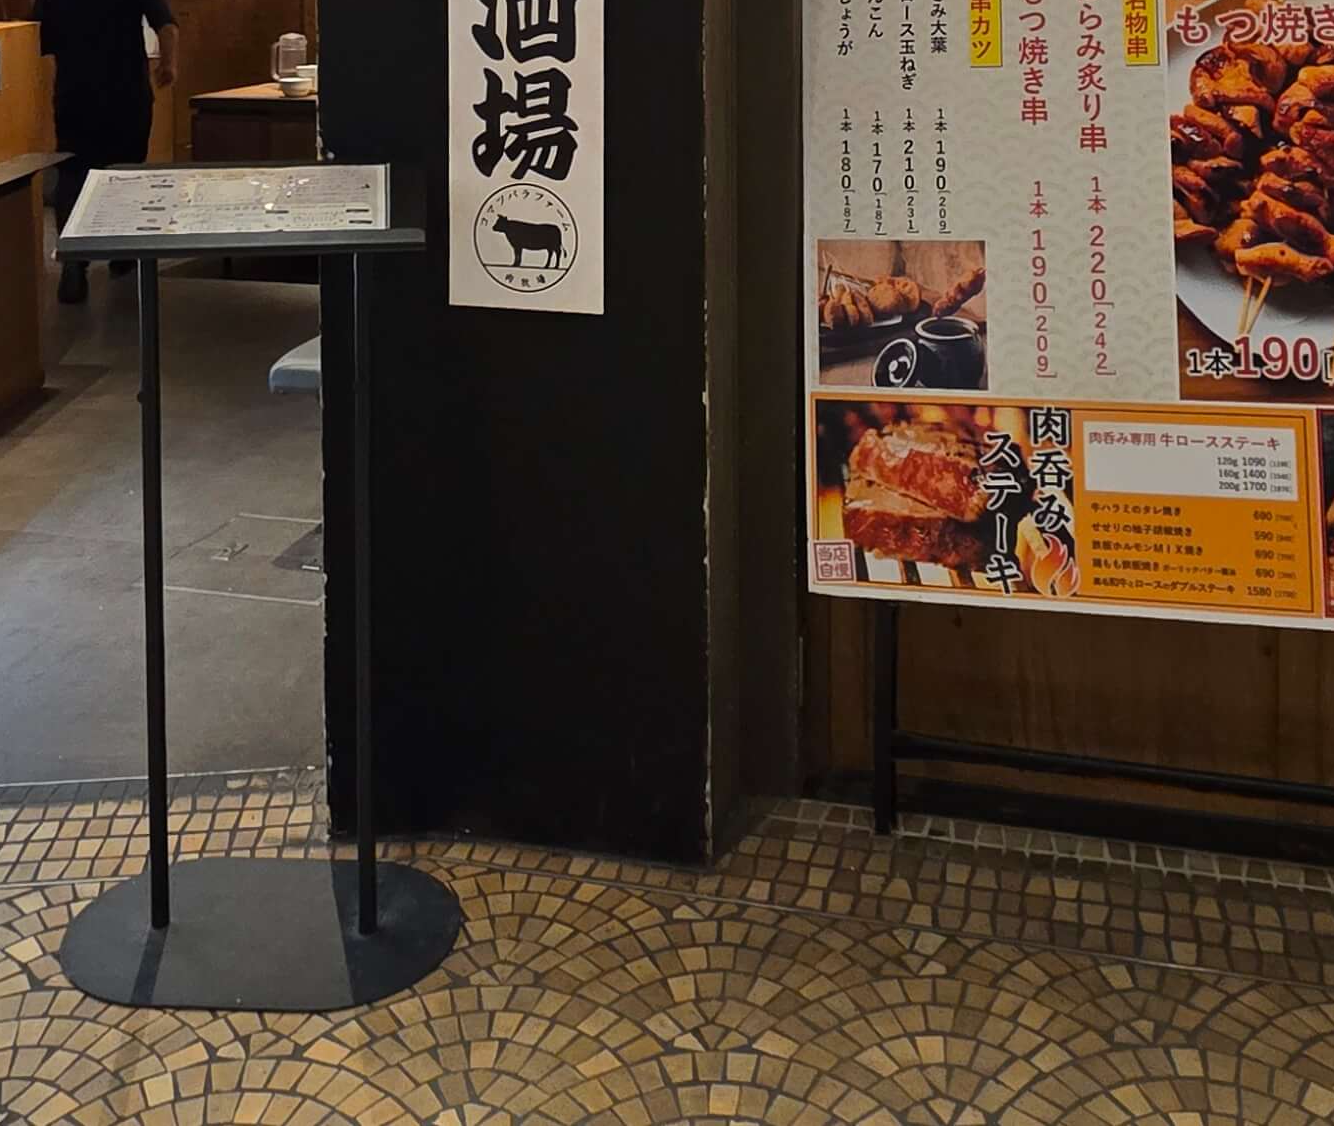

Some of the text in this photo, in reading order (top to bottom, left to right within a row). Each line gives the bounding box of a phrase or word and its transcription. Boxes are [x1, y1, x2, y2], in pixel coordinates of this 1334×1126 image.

[1088, 431, 1281, 451] 肉呑み専用 牛ロースステーキ
[979, 405, 1074, 596] 肉呑み ステーキ
